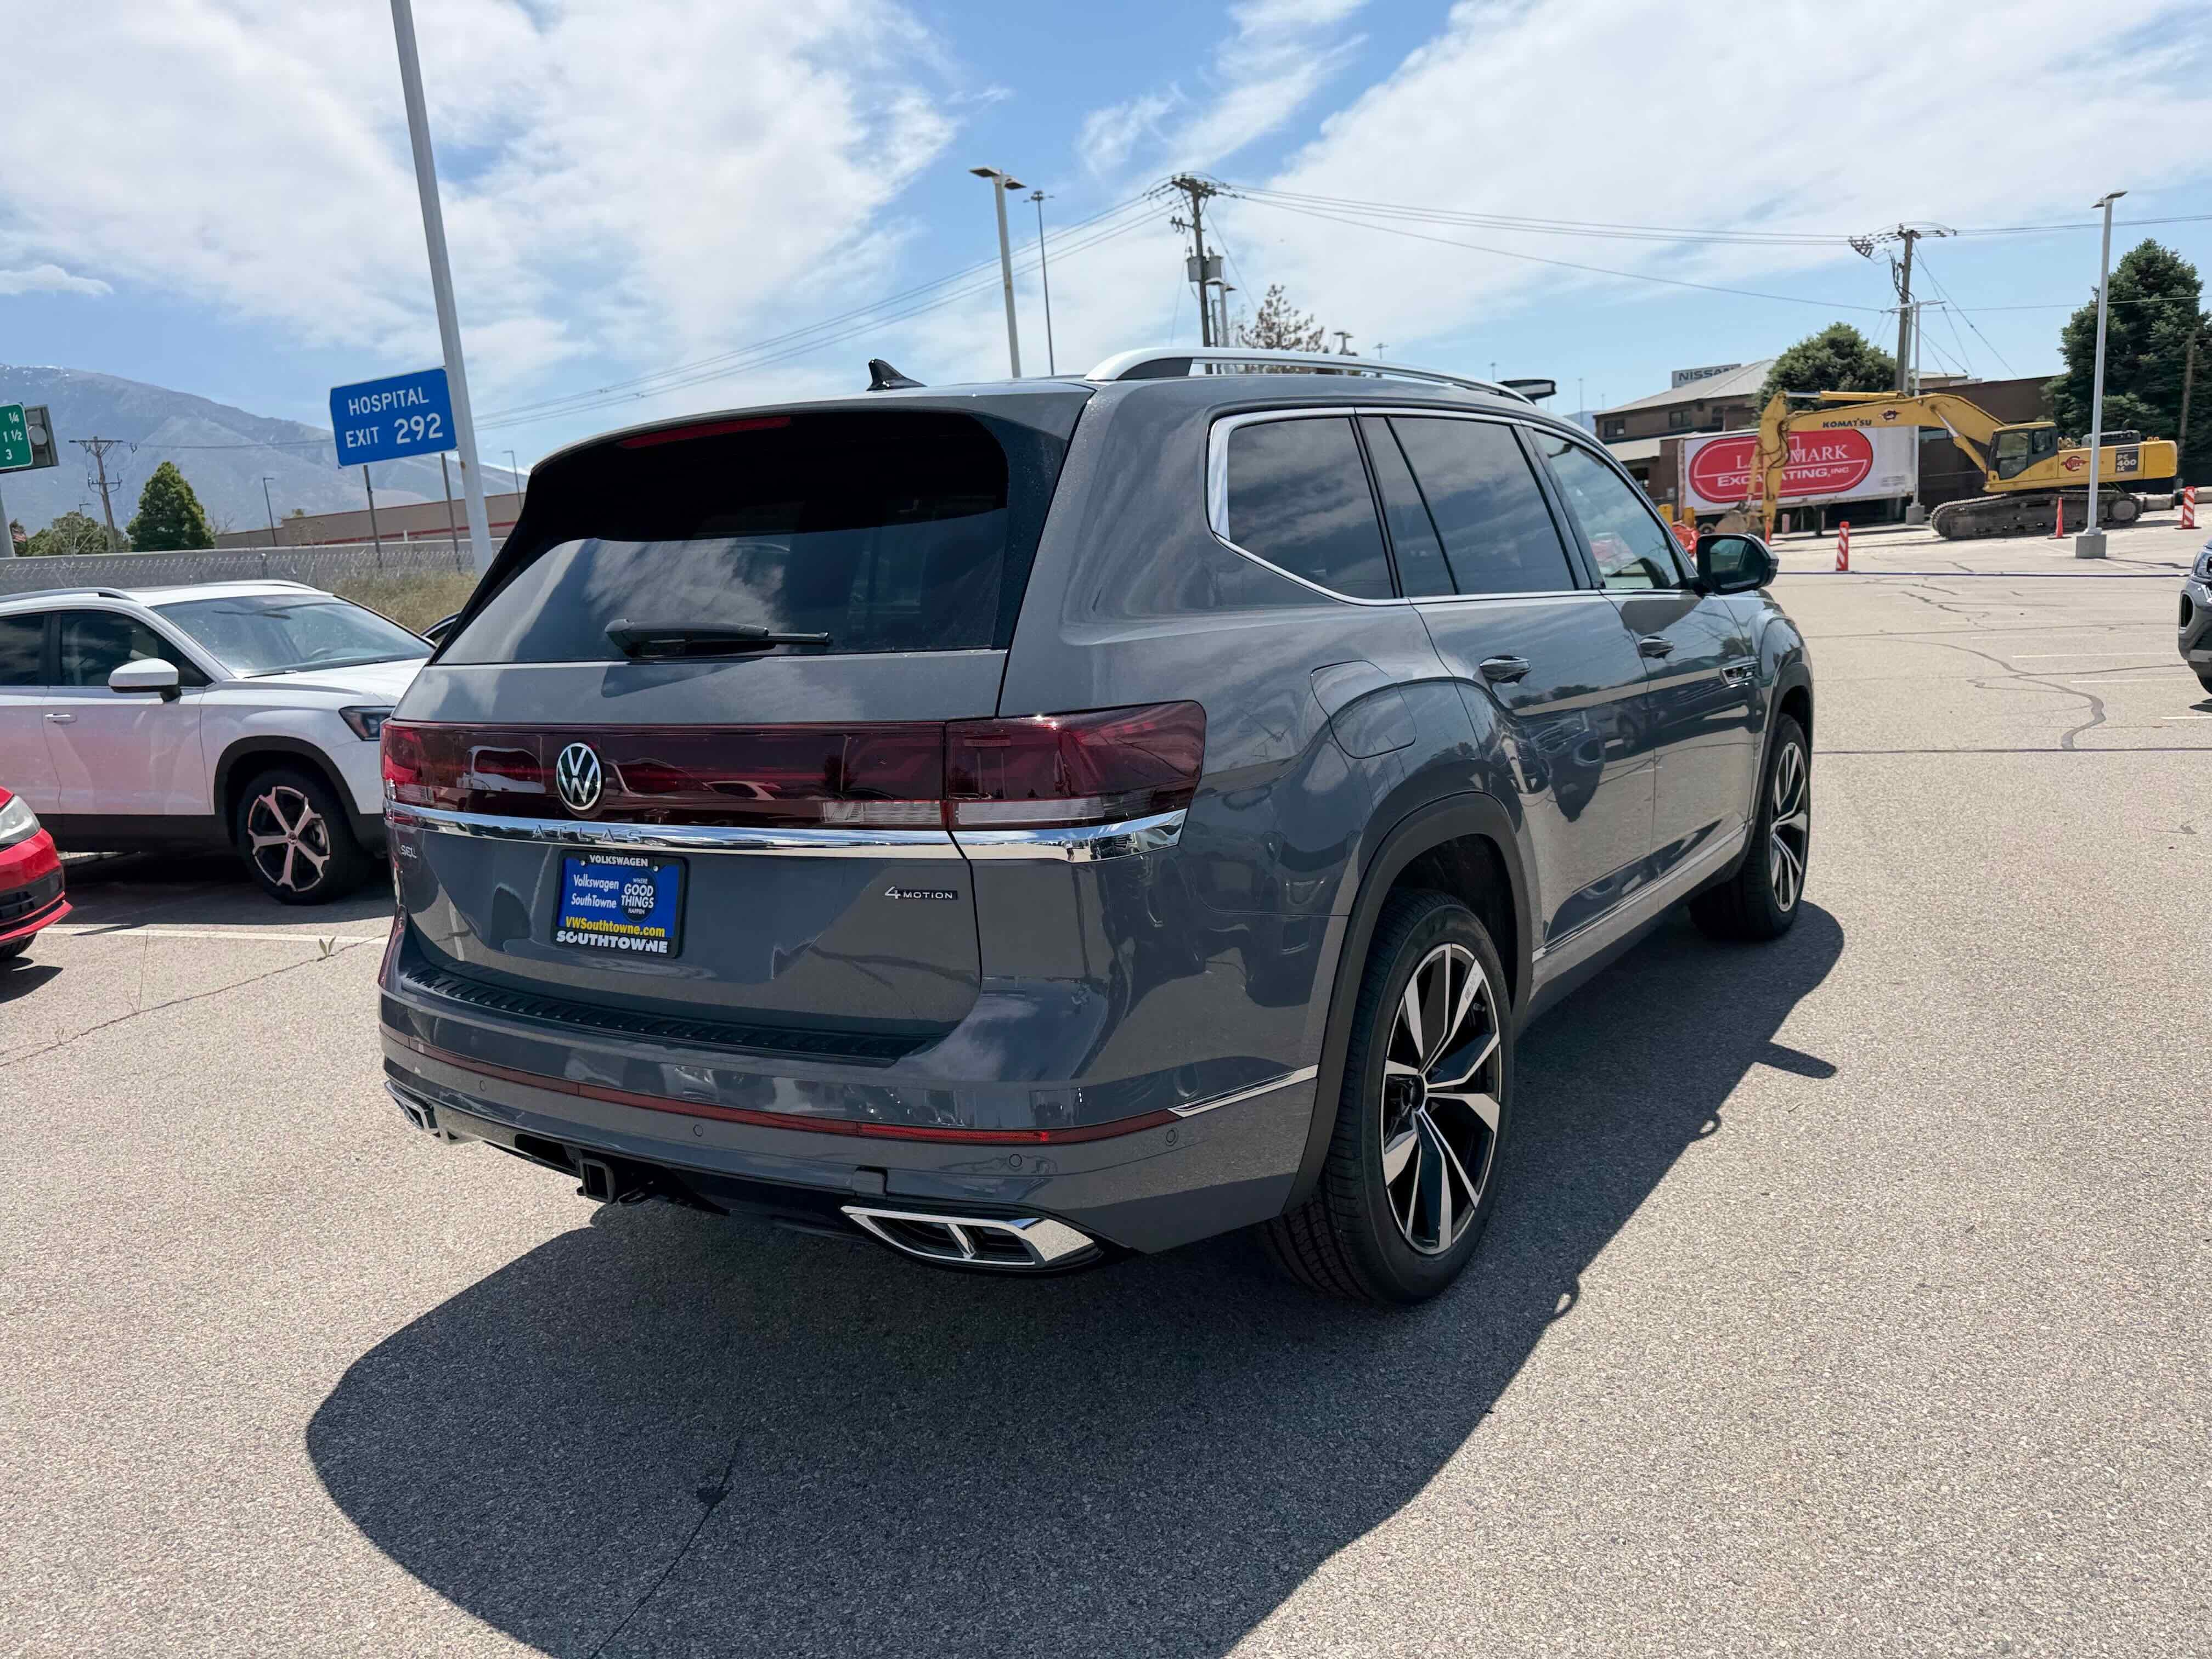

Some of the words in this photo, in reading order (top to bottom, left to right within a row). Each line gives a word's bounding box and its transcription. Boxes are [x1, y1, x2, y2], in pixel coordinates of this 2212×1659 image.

[348, 386, 430, 416] HOSPITAL
[345, 426, 380, 448] EXIT
[394, 413, 443, 444] 292
[1822, 419, 1872, 428] KOMATSU
[3, 431, 8, 443] 1
[5, 448, 13, 460] 3
[532, 825, 641, 843] ATLAS
[400, 845, 417, 859] SEL
[589, 855, 648, 867] VOLKSWAGEN
[573, 874, 619, 892] Volkswagen
[624, 883, 654, 896] GOOD
[884, 886, 953, 899] 4MOTION
[621, 895, 654, 909] THINGS
[566, 916, 665, 937] VWSouthtowne.com
[556, 930, 668, 953] SOUTHTOWNE
